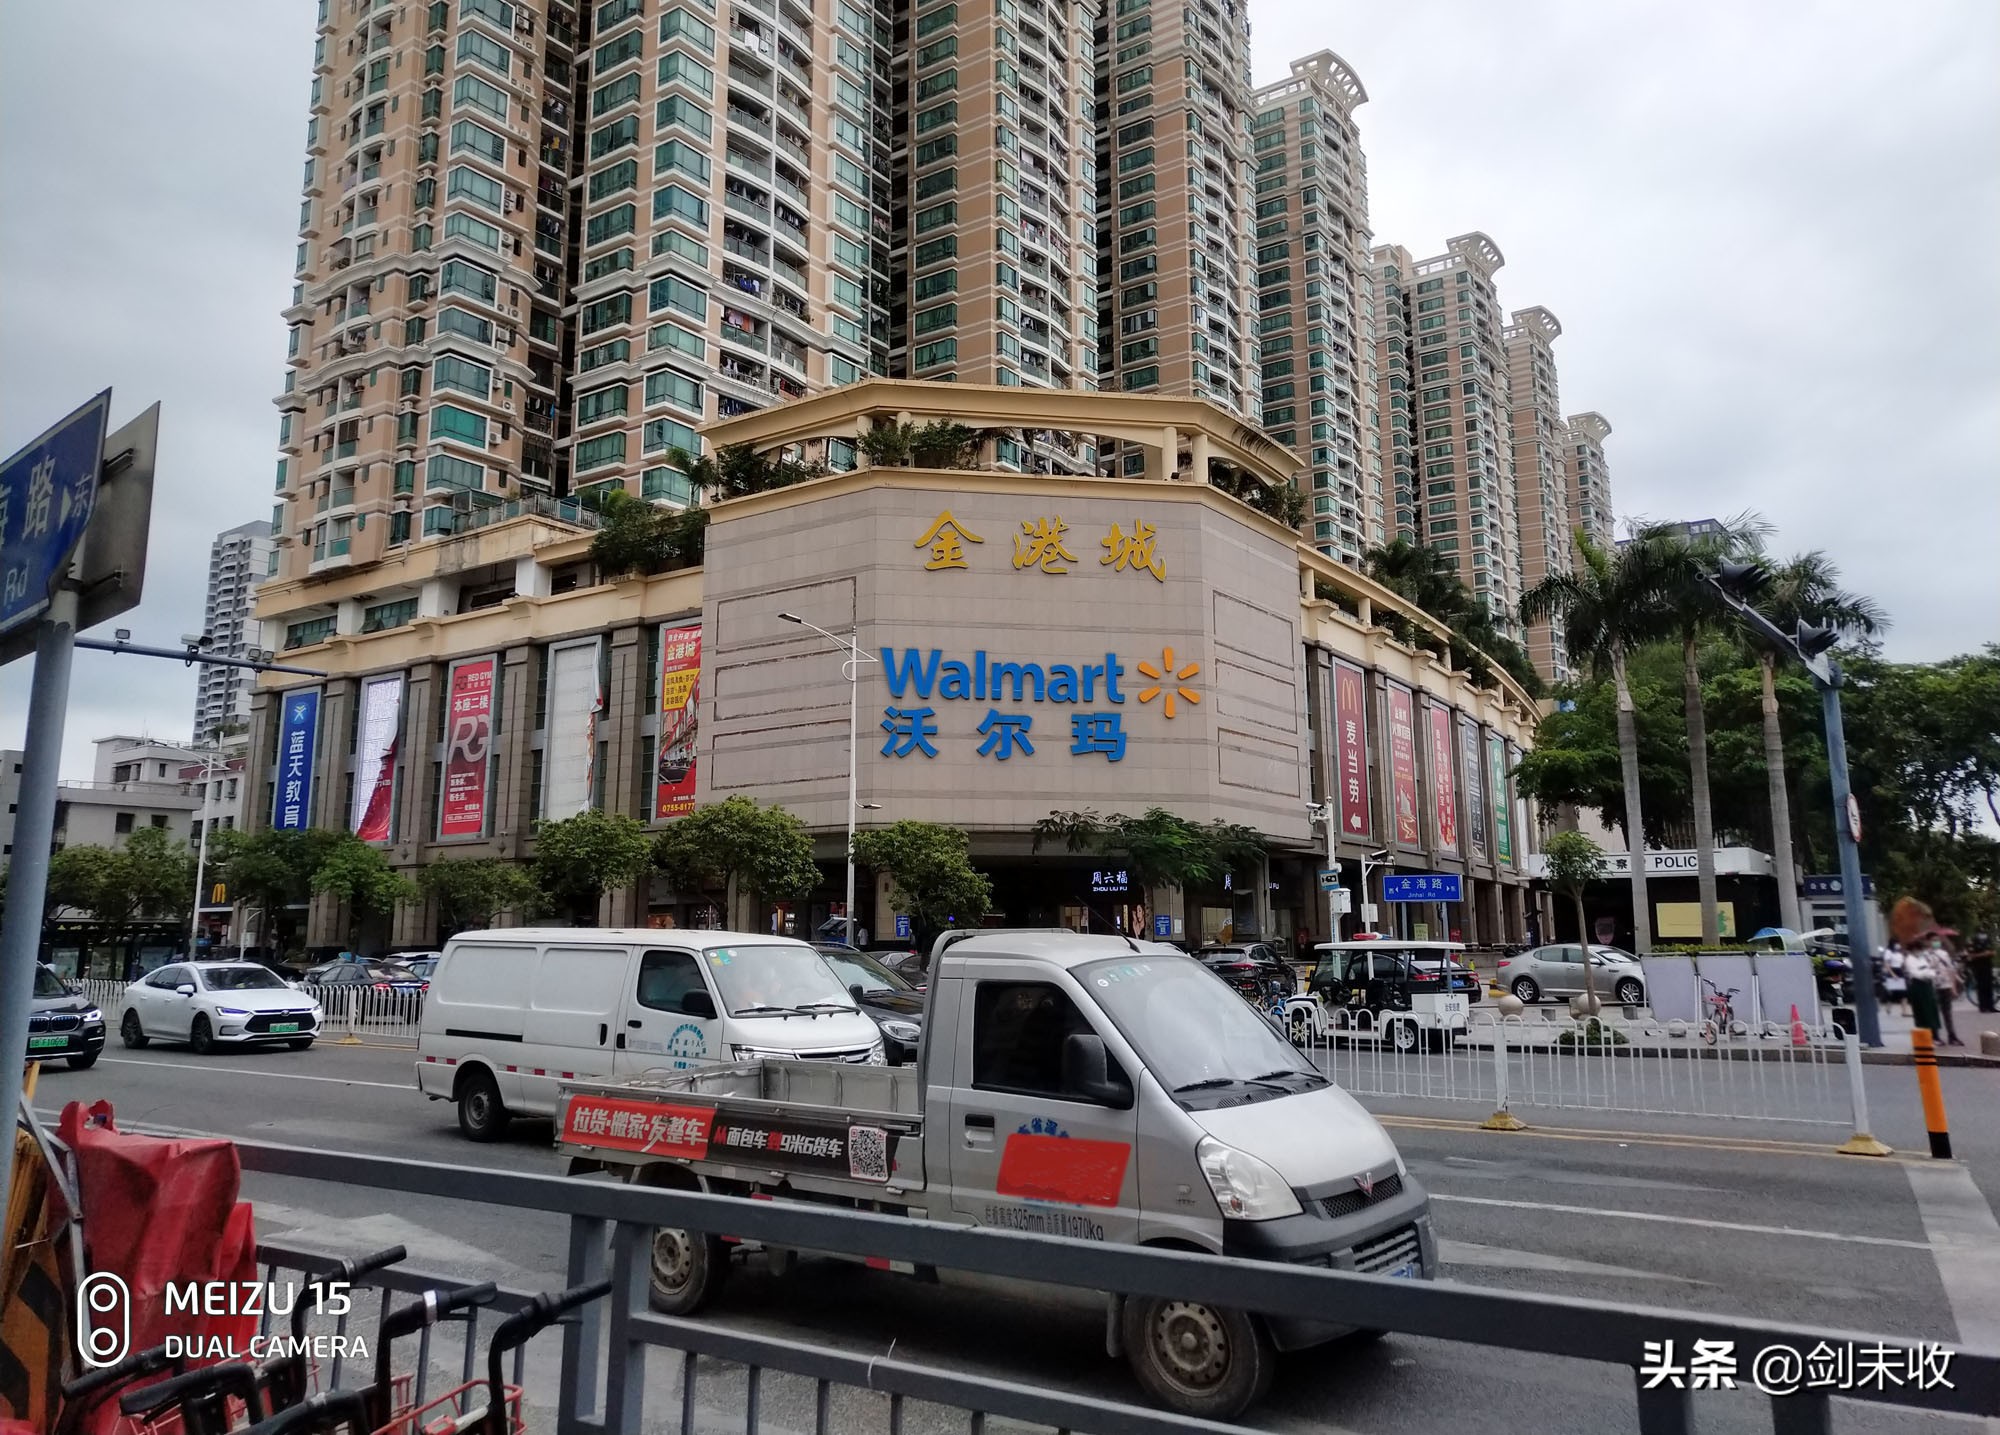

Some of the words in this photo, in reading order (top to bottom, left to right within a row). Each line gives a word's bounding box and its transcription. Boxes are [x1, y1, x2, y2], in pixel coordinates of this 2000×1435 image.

[915, 510, 1168, 582] 金港城
[4, 558, 30, 606] Rd
[881, 647, 1125, 704] Walmart
[880, 706, 1128, 762] 沃尔玛
[1345, 719, 1359, 803] 麦当劳
[284, 730, 306, 827] 蓝天教育
[1091, 870, 1128, 885] 周六福
[1401, 878, 1442, 889] 金海路
[1655, 856, 1697, 868] POLIC
